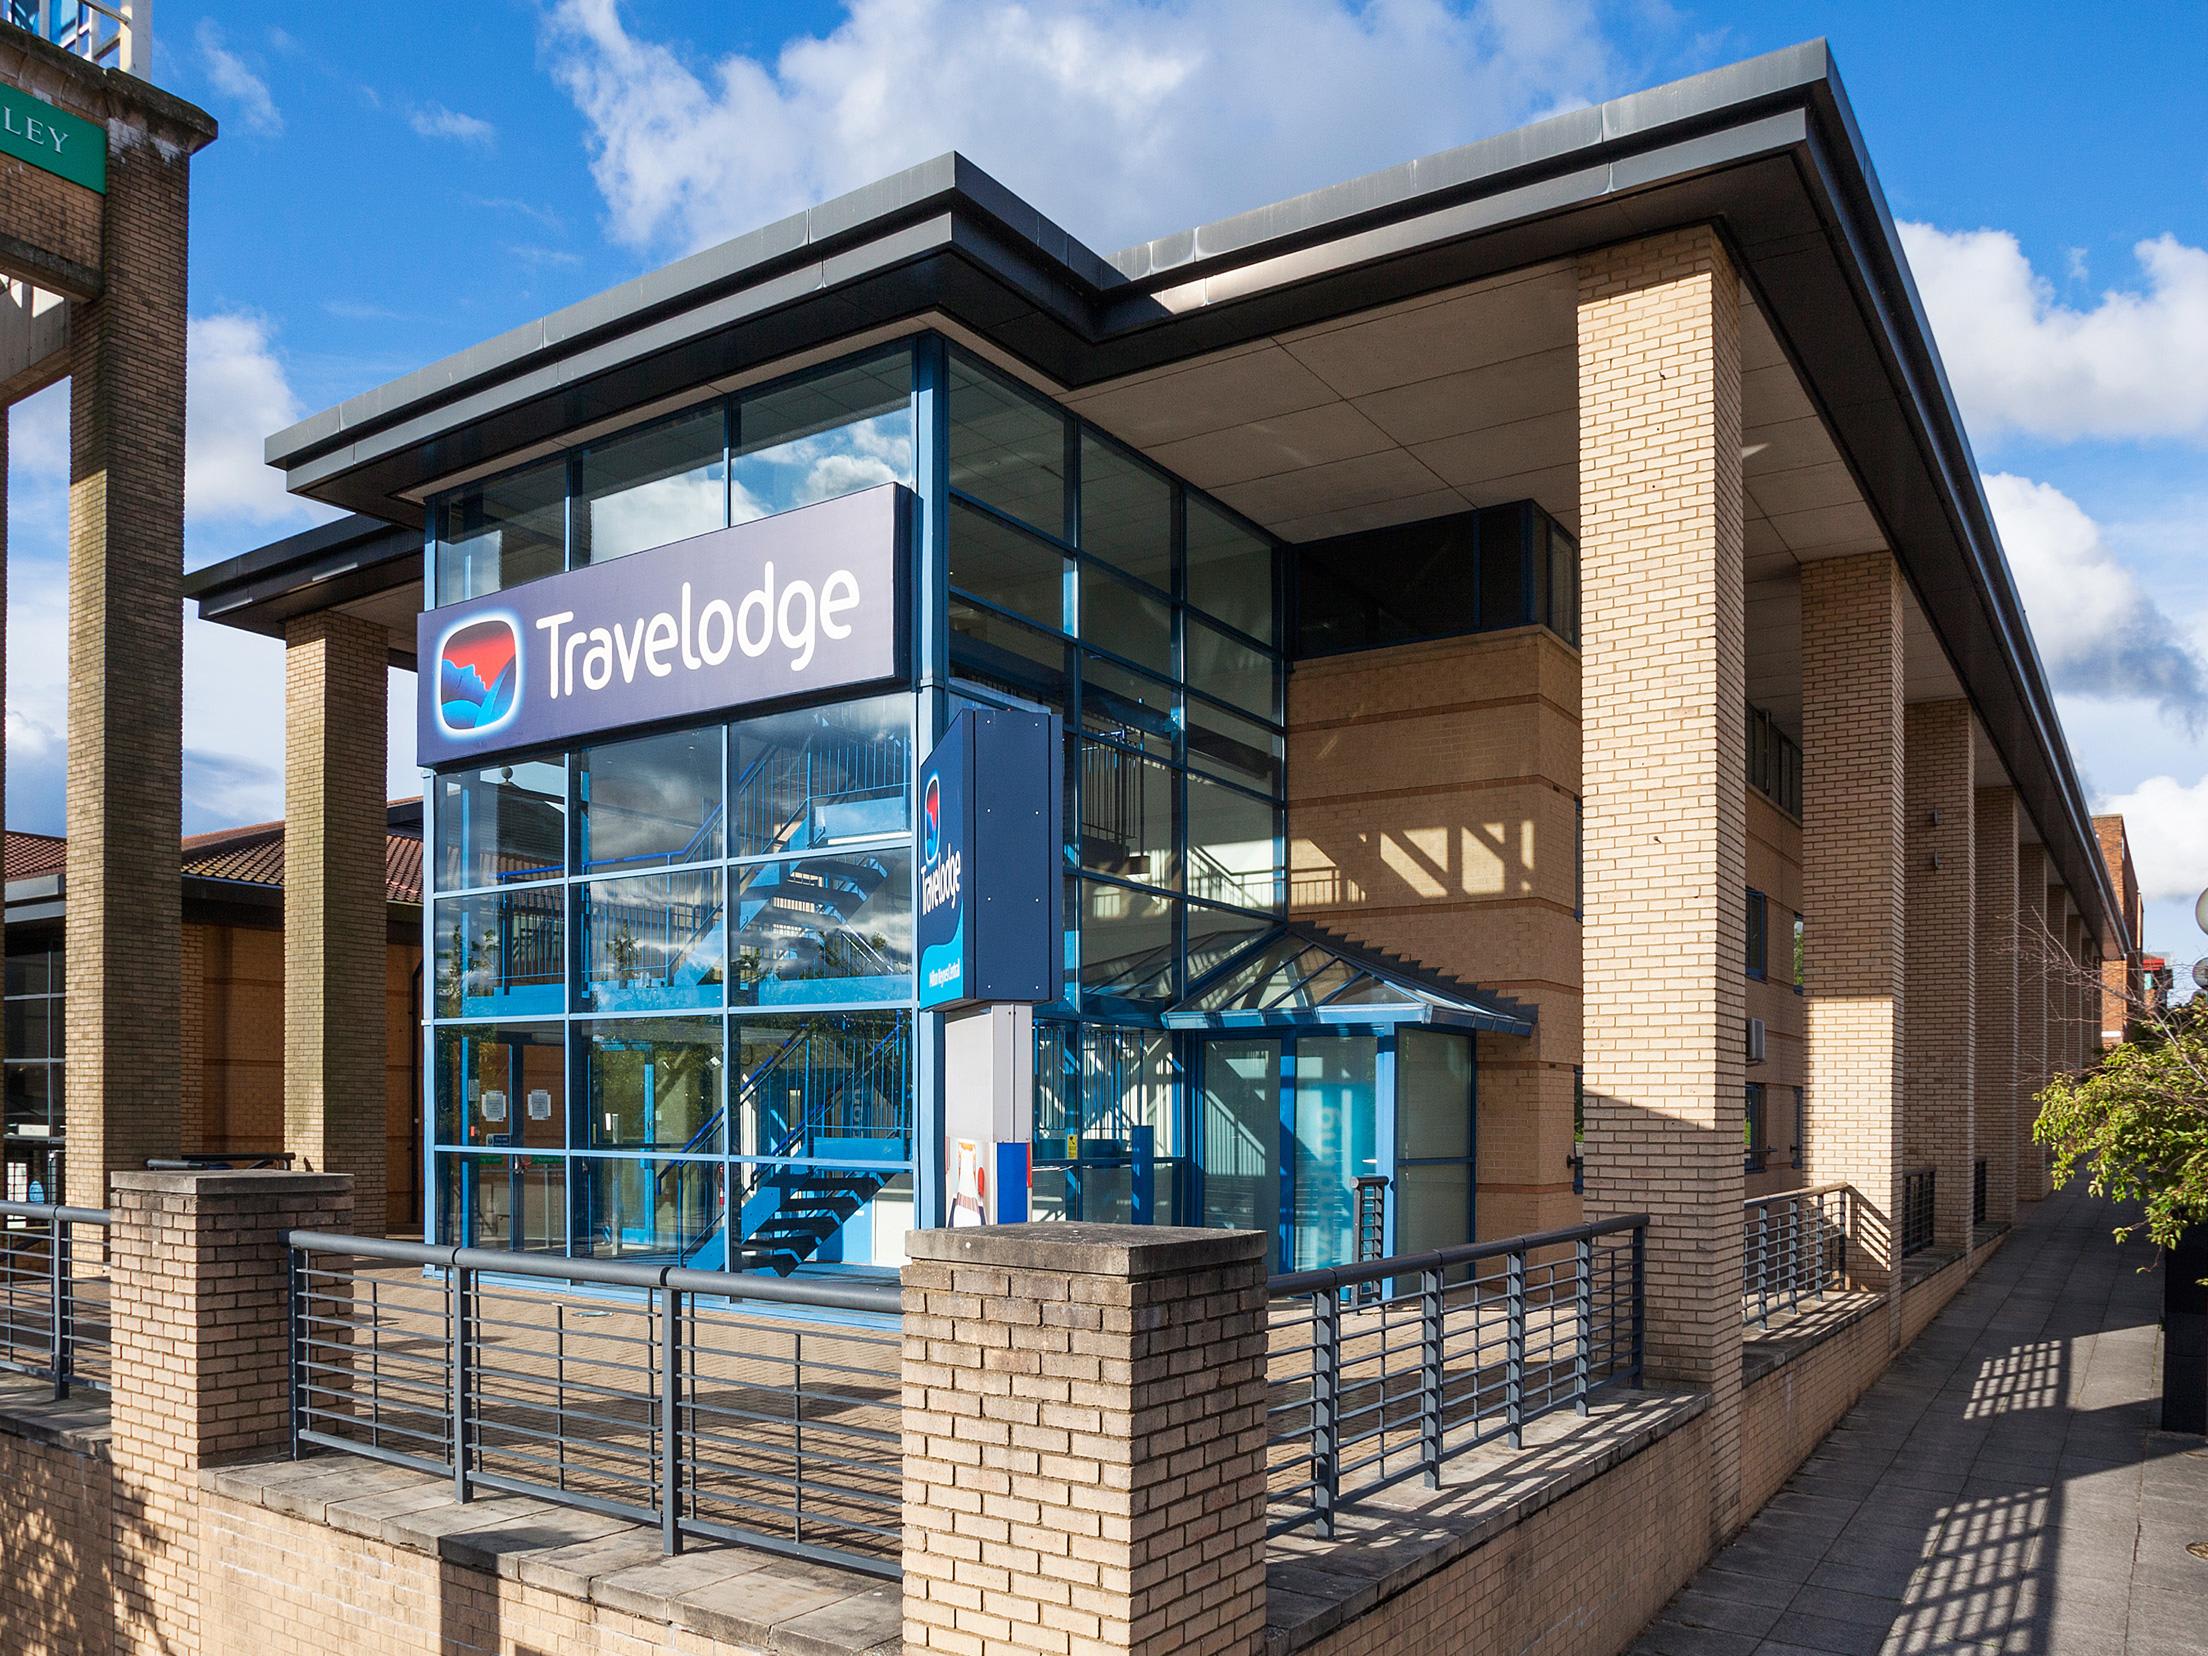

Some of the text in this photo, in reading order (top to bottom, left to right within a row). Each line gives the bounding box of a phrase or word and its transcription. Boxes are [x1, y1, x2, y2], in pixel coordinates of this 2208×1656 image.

[3, 105, 69, 154] LEY
[536, 561, 860, 699] Travelodge
[921, 843, 961, 916] Travelodge
